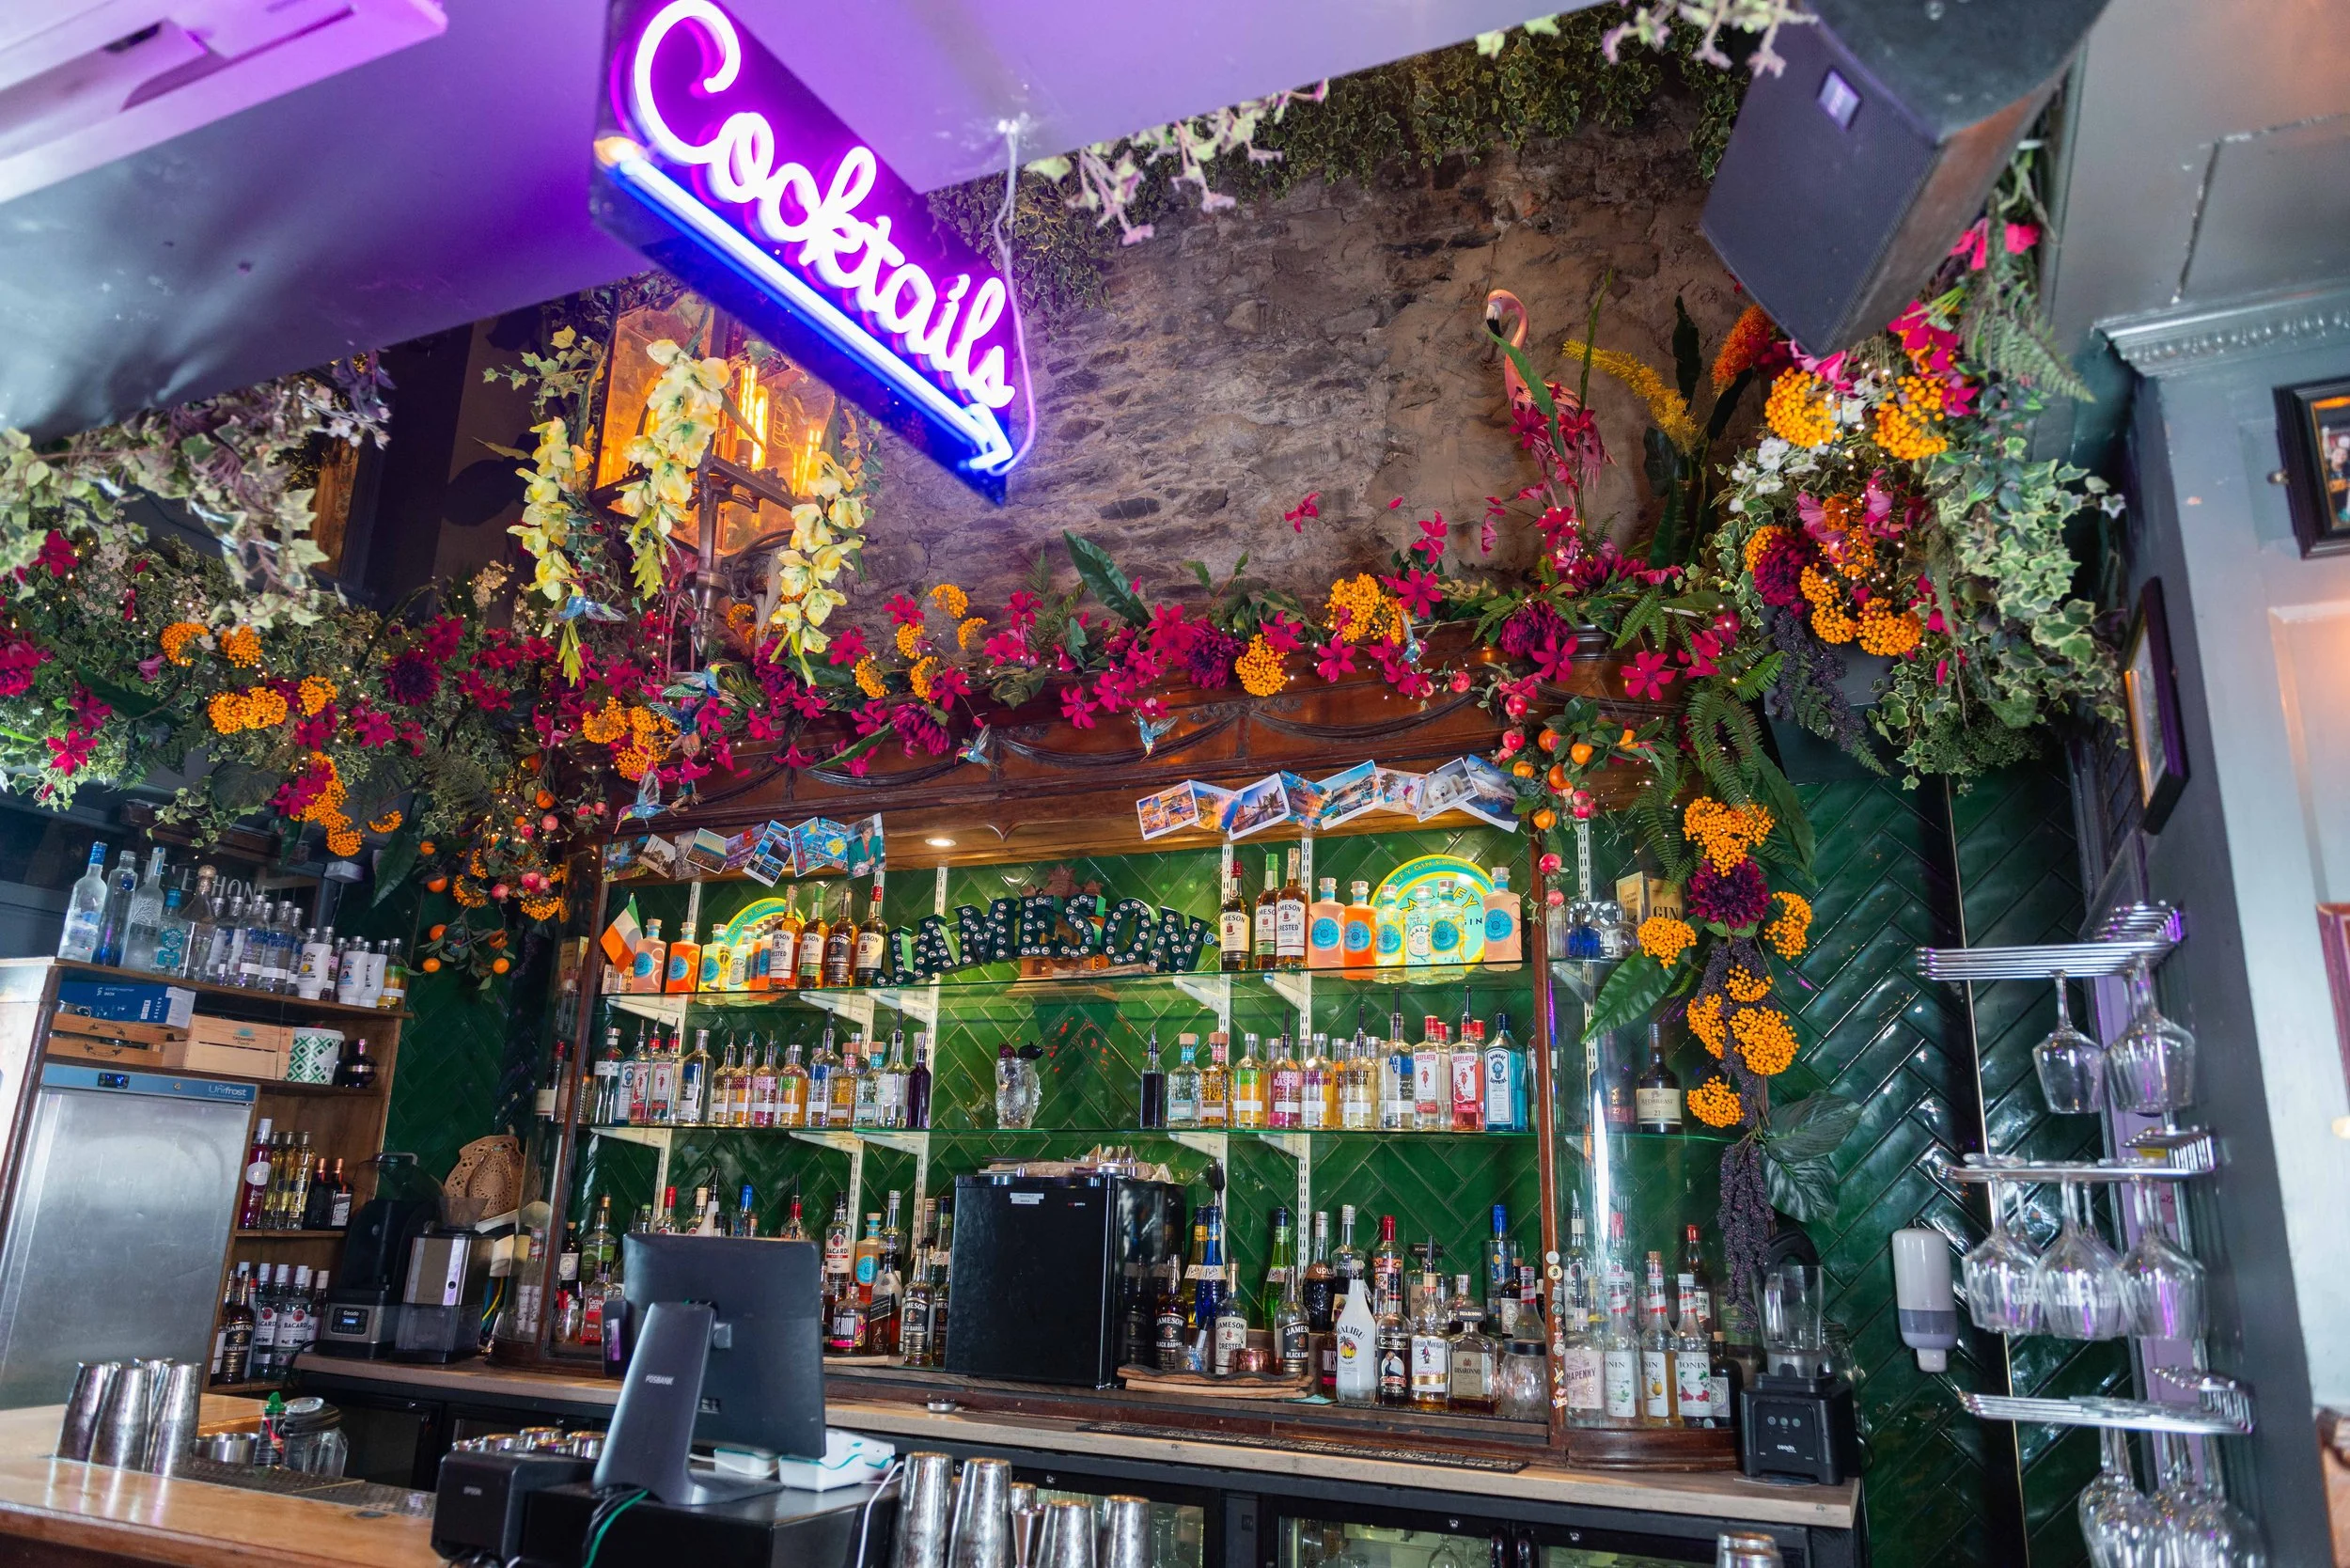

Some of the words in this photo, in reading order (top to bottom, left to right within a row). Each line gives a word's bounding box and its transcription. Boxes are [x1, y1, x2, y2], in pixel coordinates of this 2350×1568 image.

[634, 0, 1016, 408] Cocktails
[1653, 905, 1680, 921] GIN
[872, 893, 1212, 987] JAMESON
[1416, 1054, 1436, 1062] BEEFEATER
[209, 1084, 248, 1097] Unifrost
[1156, 1317, 1183, 1327] JAMESON
[1217, 1322, 1244, 1330] JAMESON
[1338, 1325, 1365, 1340] MALIBU
[1567, 1368, 1596, 1381] HAPENNY
